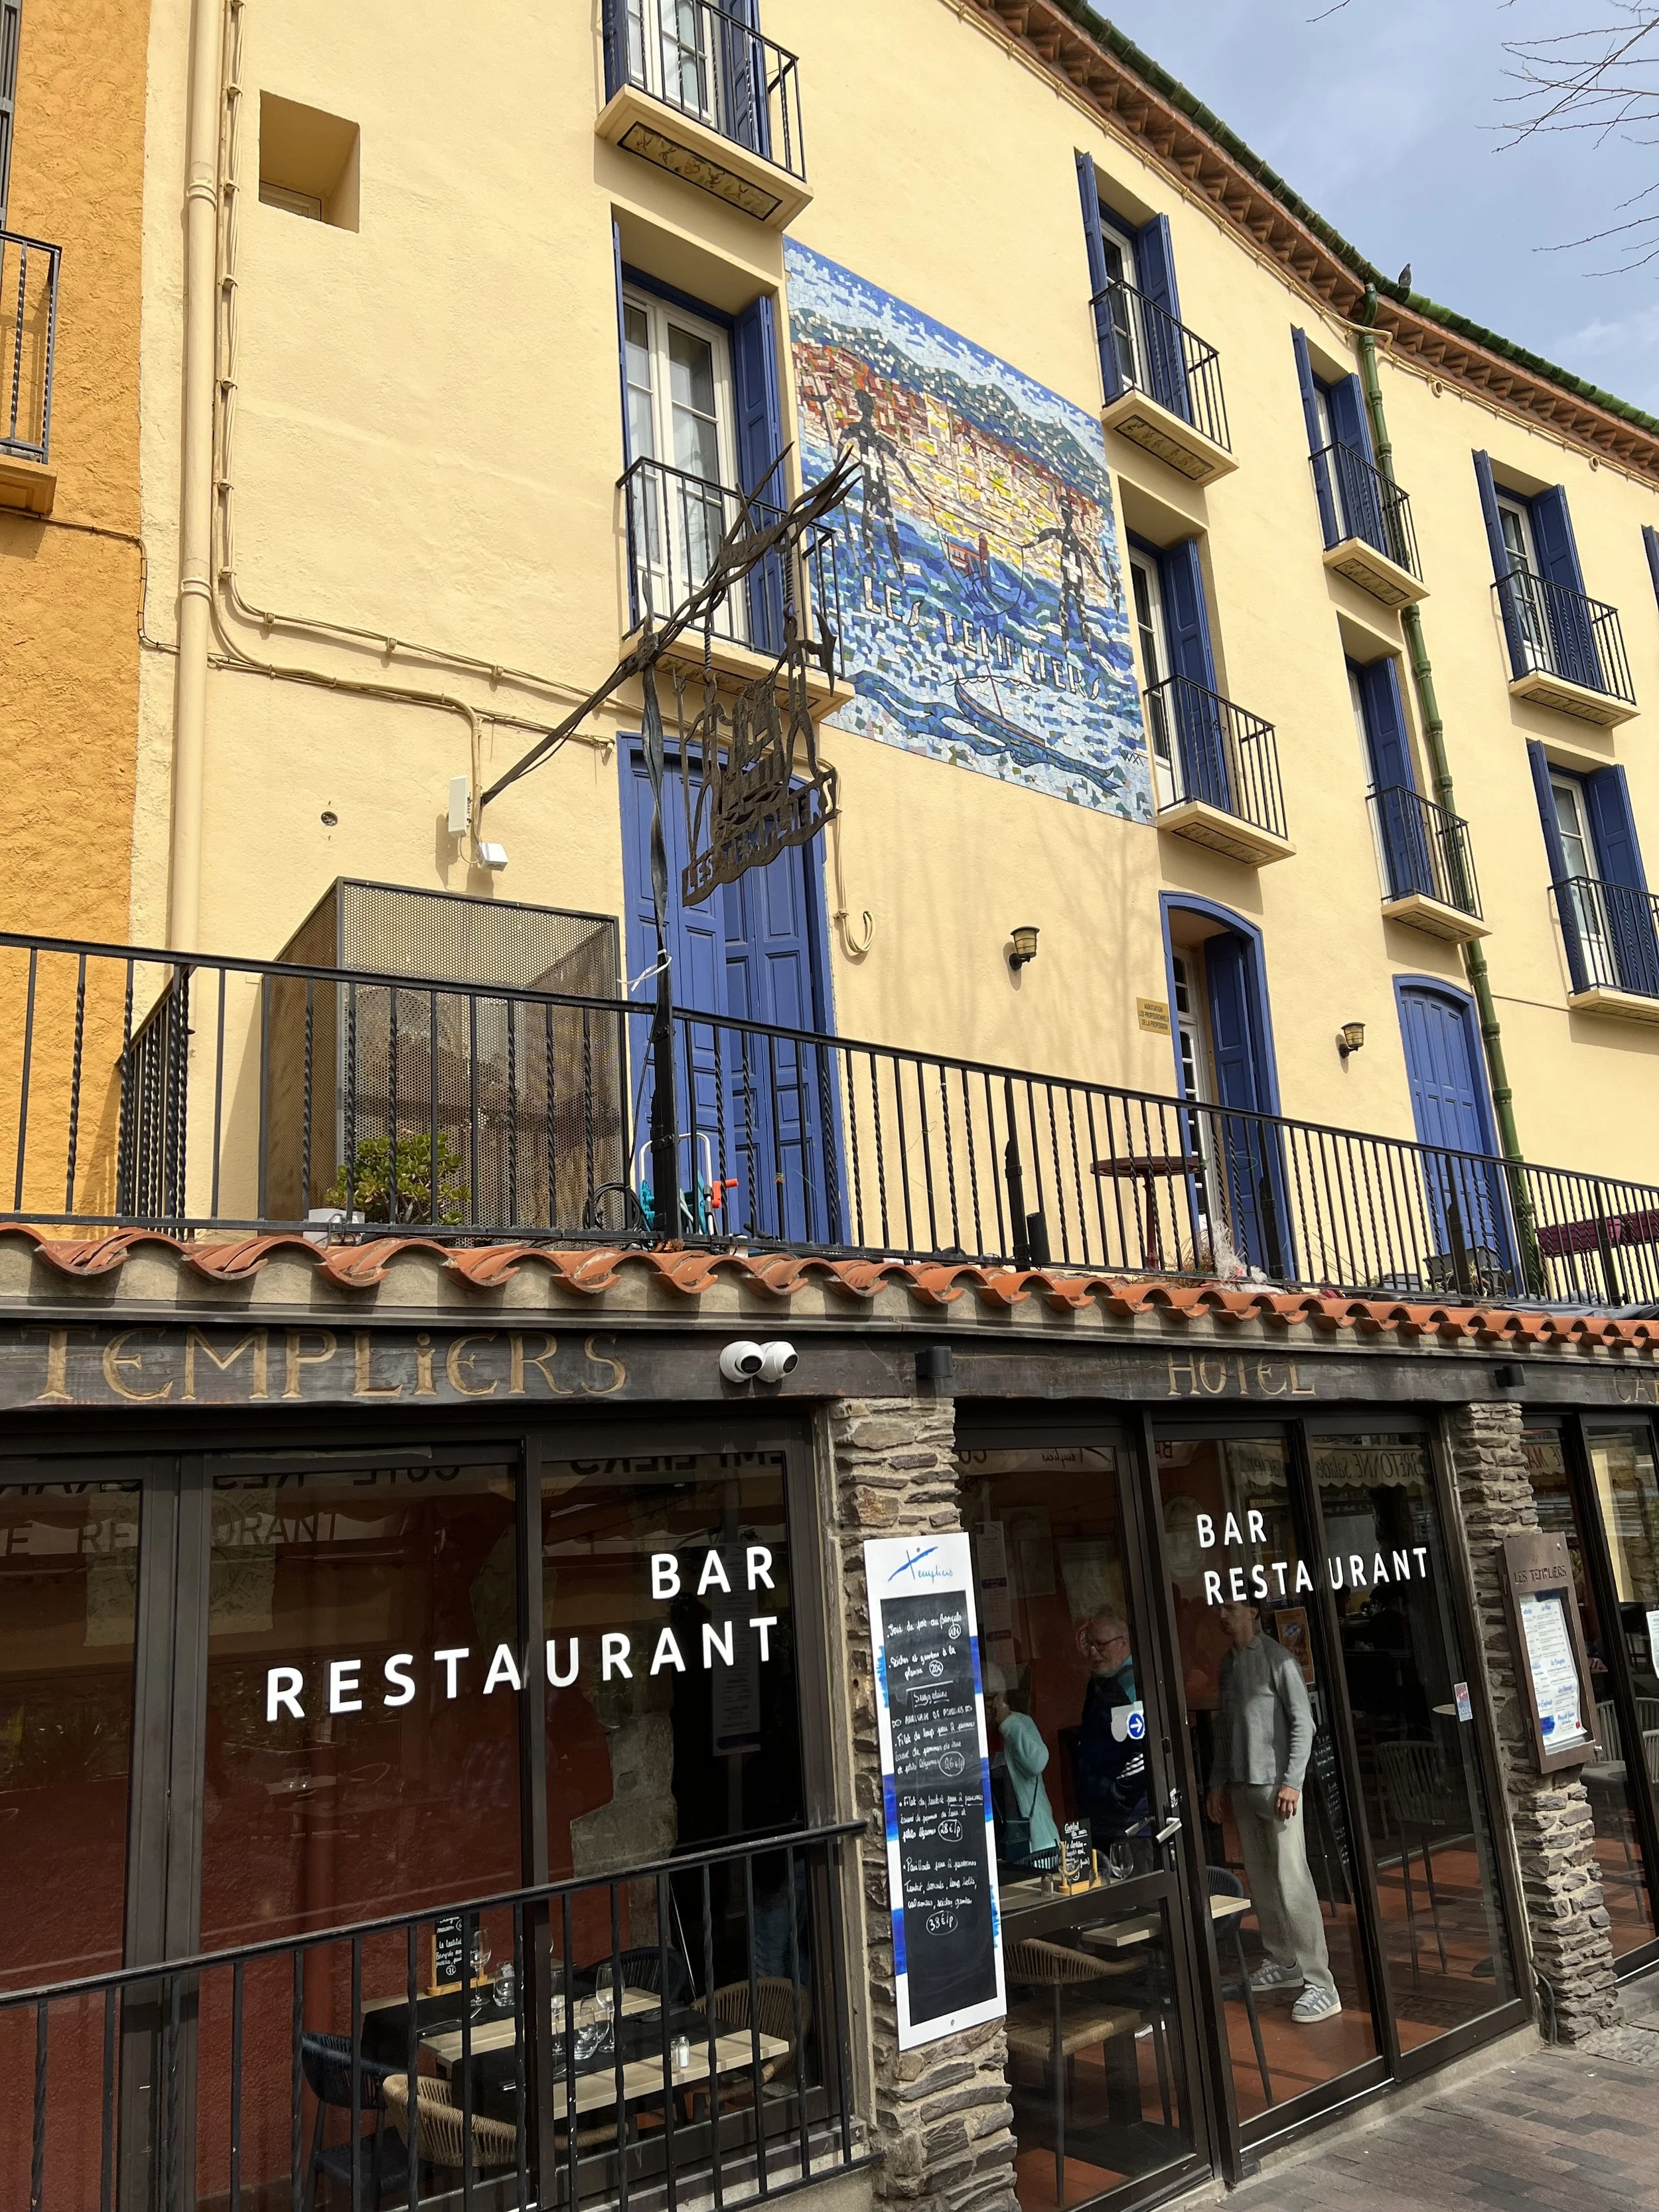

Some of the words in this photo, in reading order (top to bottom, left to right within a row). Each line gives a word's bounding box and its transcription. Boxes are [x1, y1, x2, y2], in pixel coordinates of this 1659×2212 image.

[862, 575, 924, 627] LES
[938, 608, 1102, 701] TEMPLIERS
[1167, 1349, 1317, 1396] HOTEL
[1196, 1509, 1267, 1549] BAR
[652, 1546, 776, 1600] BAR
[1204, 1547, 1427, 1606] RESTAURANT
[1514, 1570, 1528, 1584] LES
[1529, 1565, 1567, 1583] TEMPLIERS
[266, 1615, 778, 1722] RESTAURANT
[948, 1645, 956, 1655] la
